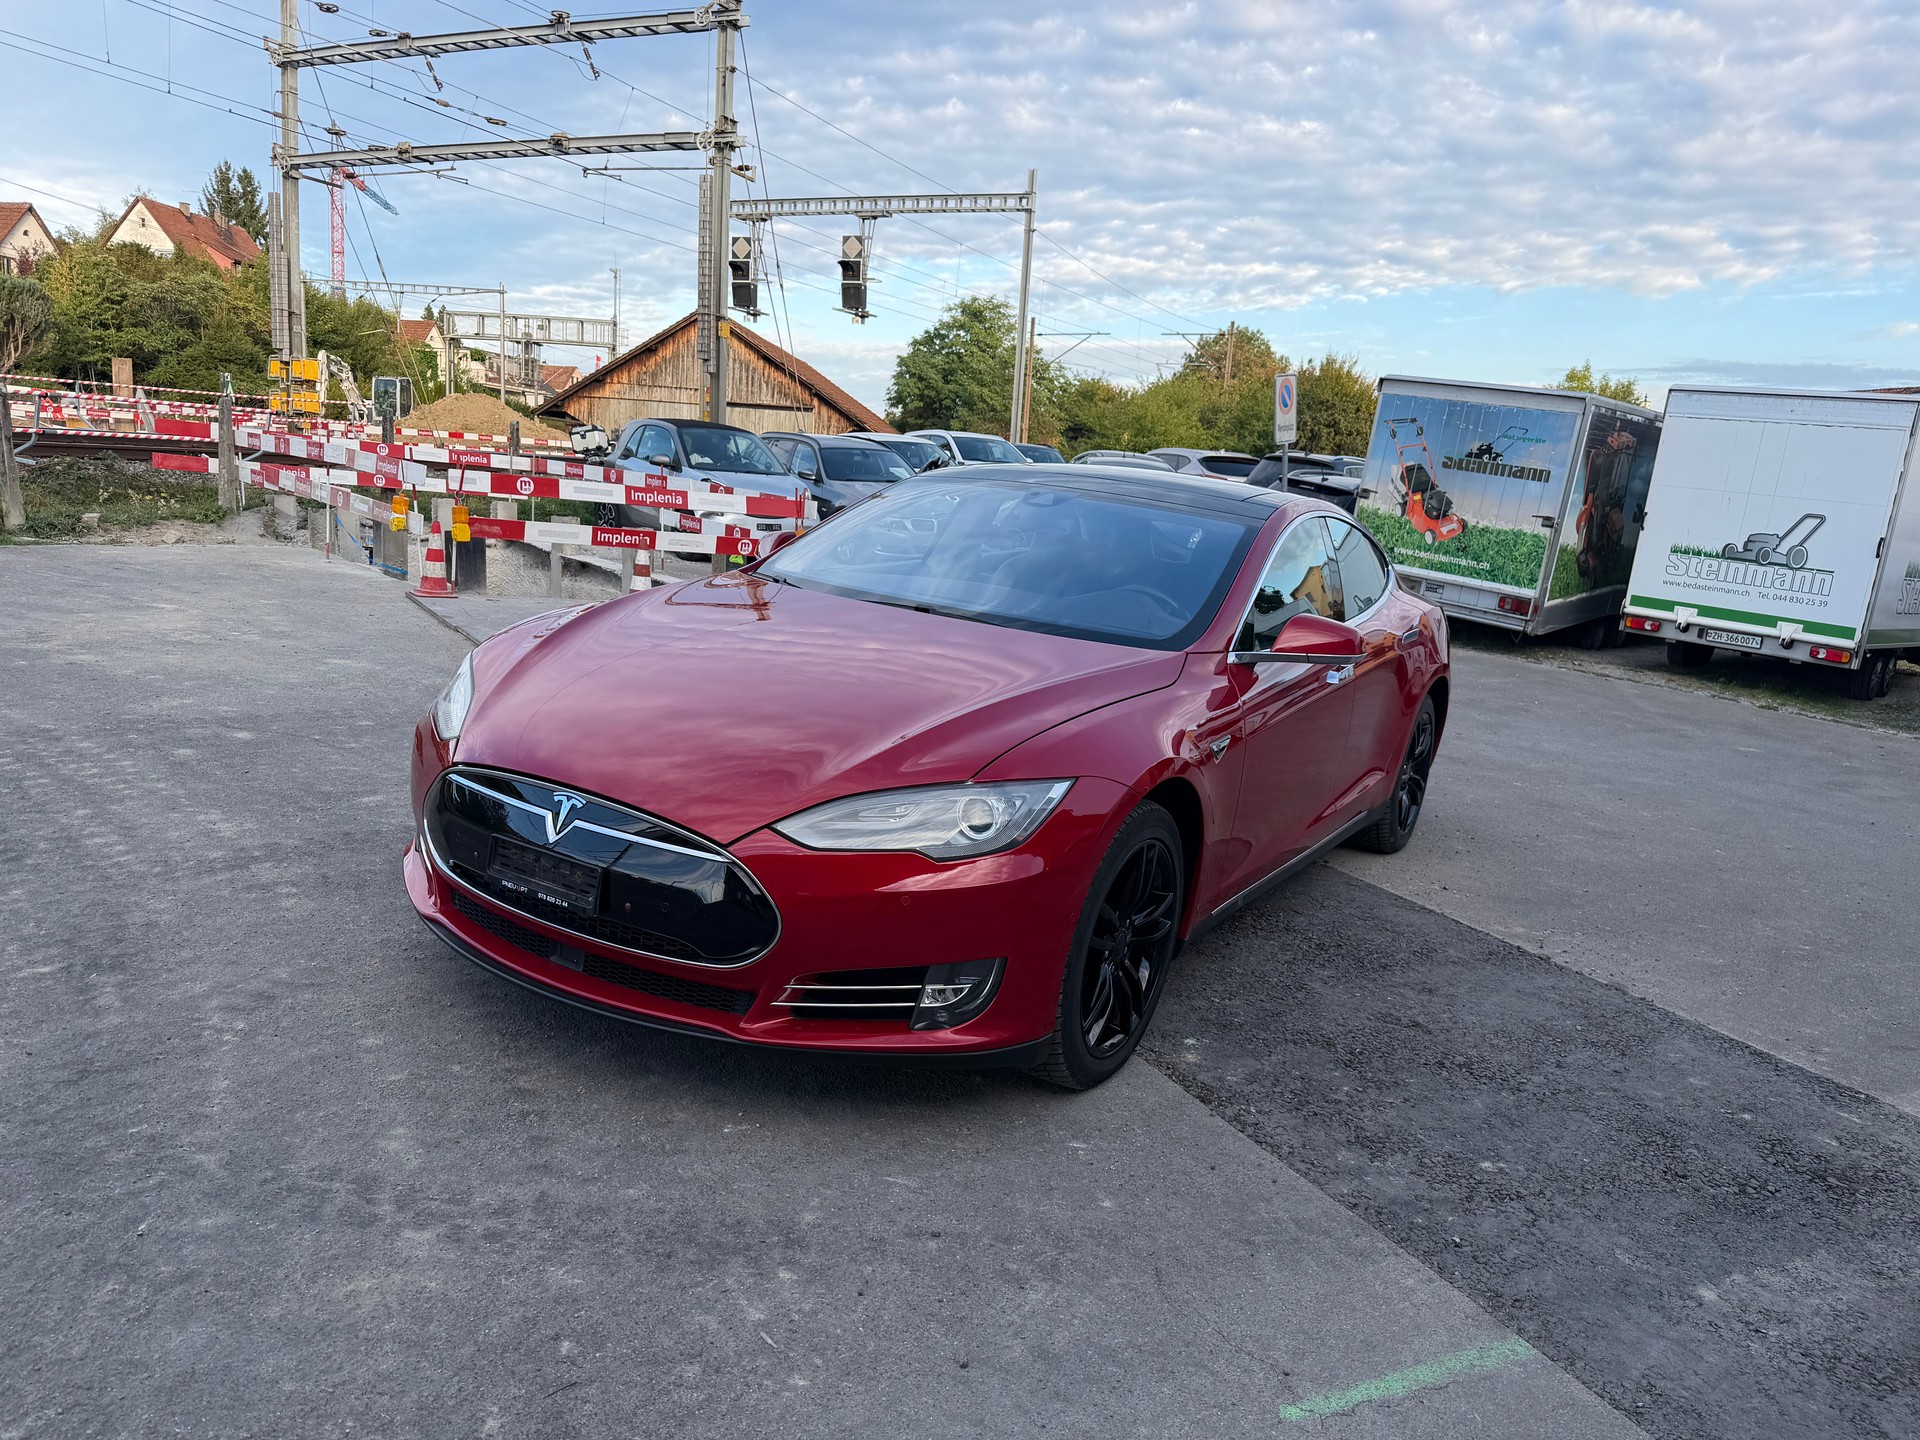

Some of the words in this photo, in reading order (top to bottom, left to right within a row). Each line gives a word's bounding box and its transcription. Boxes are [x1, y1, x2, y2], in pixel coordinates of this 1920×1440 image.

[377, 459, 397, 474] Implenia
[566, 464, 583, 476] Implenia
[631, 489, 683, 505] Implenia
[680, 516, 700, 530] Implenia
[1665, 553, 1835, 597] Steinmann
[1662, 579, 1751, 598] www.bedasteinmann.ch
[1758, 591, 1771, 600] Tel.
[1772, 594, 1787, 602] 044
[1788, 596, 1804, 605] 830
[1805, 598, 1816, 606] 25
[1817, 599, 1828, 608] 39
